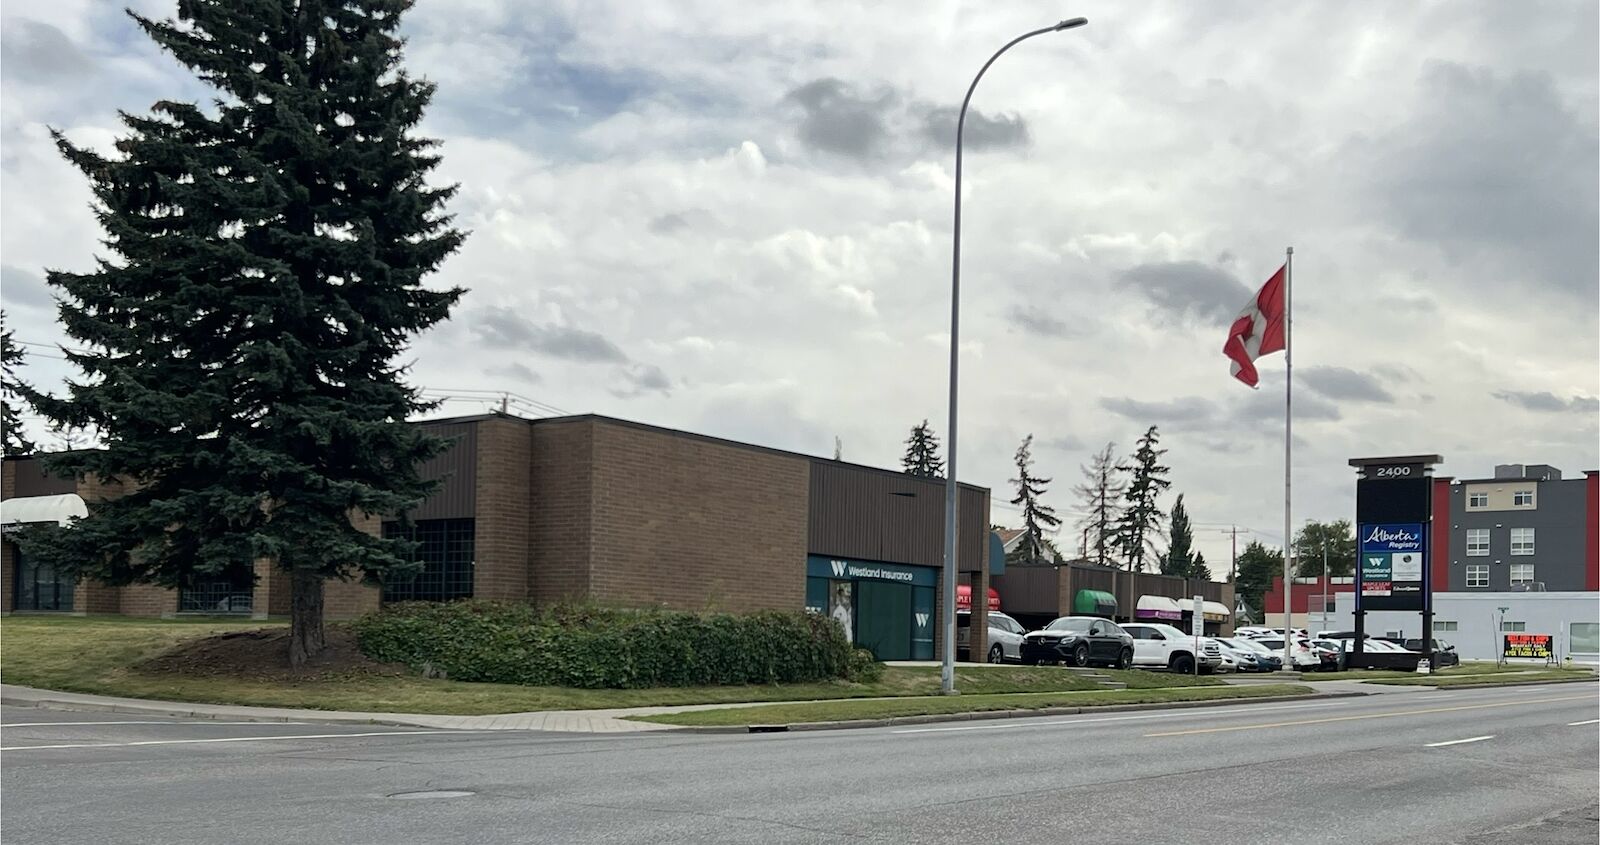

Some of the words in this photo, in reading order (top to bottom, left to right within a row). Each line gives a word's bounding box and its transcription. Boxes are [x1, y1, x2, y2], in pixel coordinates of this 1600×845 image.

[1377, 466, 1410, 476] 2400
[1364, 526, 1417, 543] Alberta
[1388, 541, 1419, 549] Registry
[848, 566, 880, 577] Westland
[881, 569, 913, 580] Insurance
